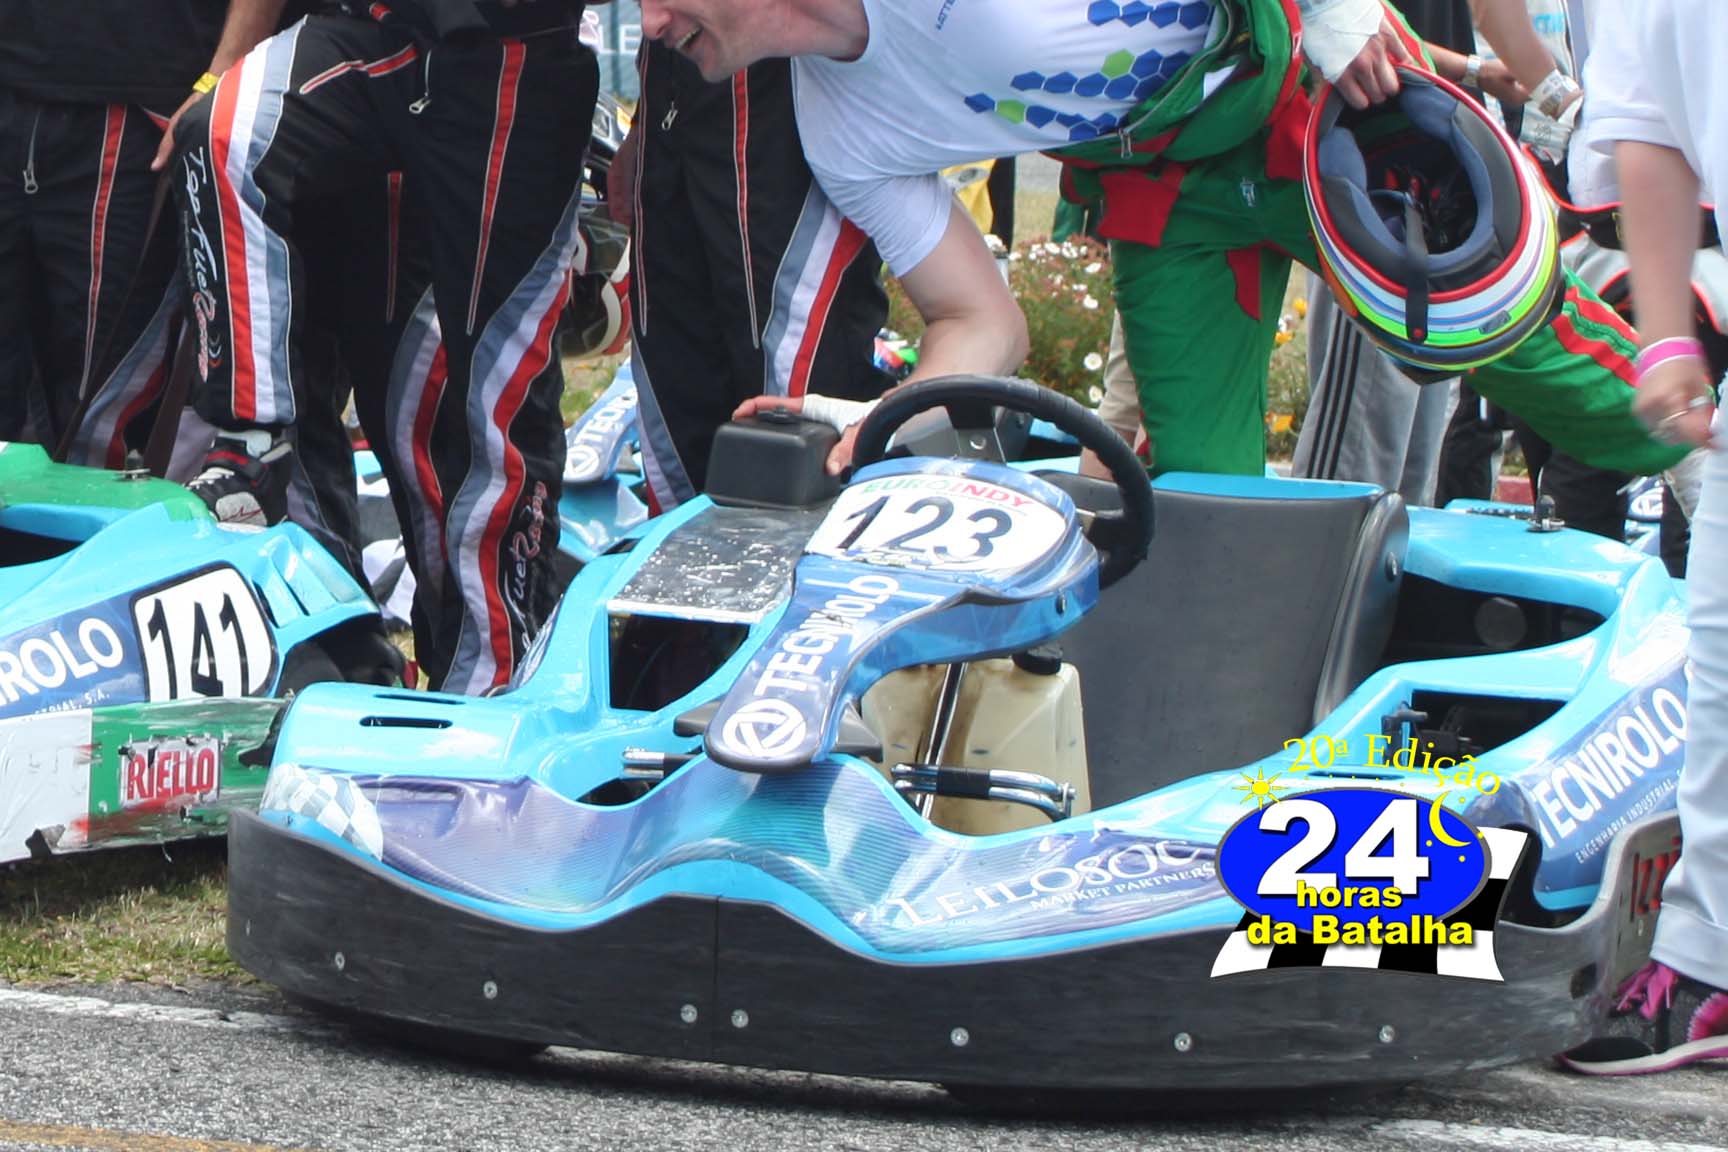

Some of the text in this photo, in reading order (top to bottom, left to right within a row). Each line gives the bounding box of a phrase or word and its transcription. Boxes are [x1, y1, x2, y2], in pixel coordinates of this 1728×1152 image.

[837, 495, 1012, 564] 123
[147, 592, 250, 700] 141
[127, 747, 215, 801] RIELLO
[892, 839, 1203, 927] LEILOSOC
[1030, 885, 1112, 912] MARKET
